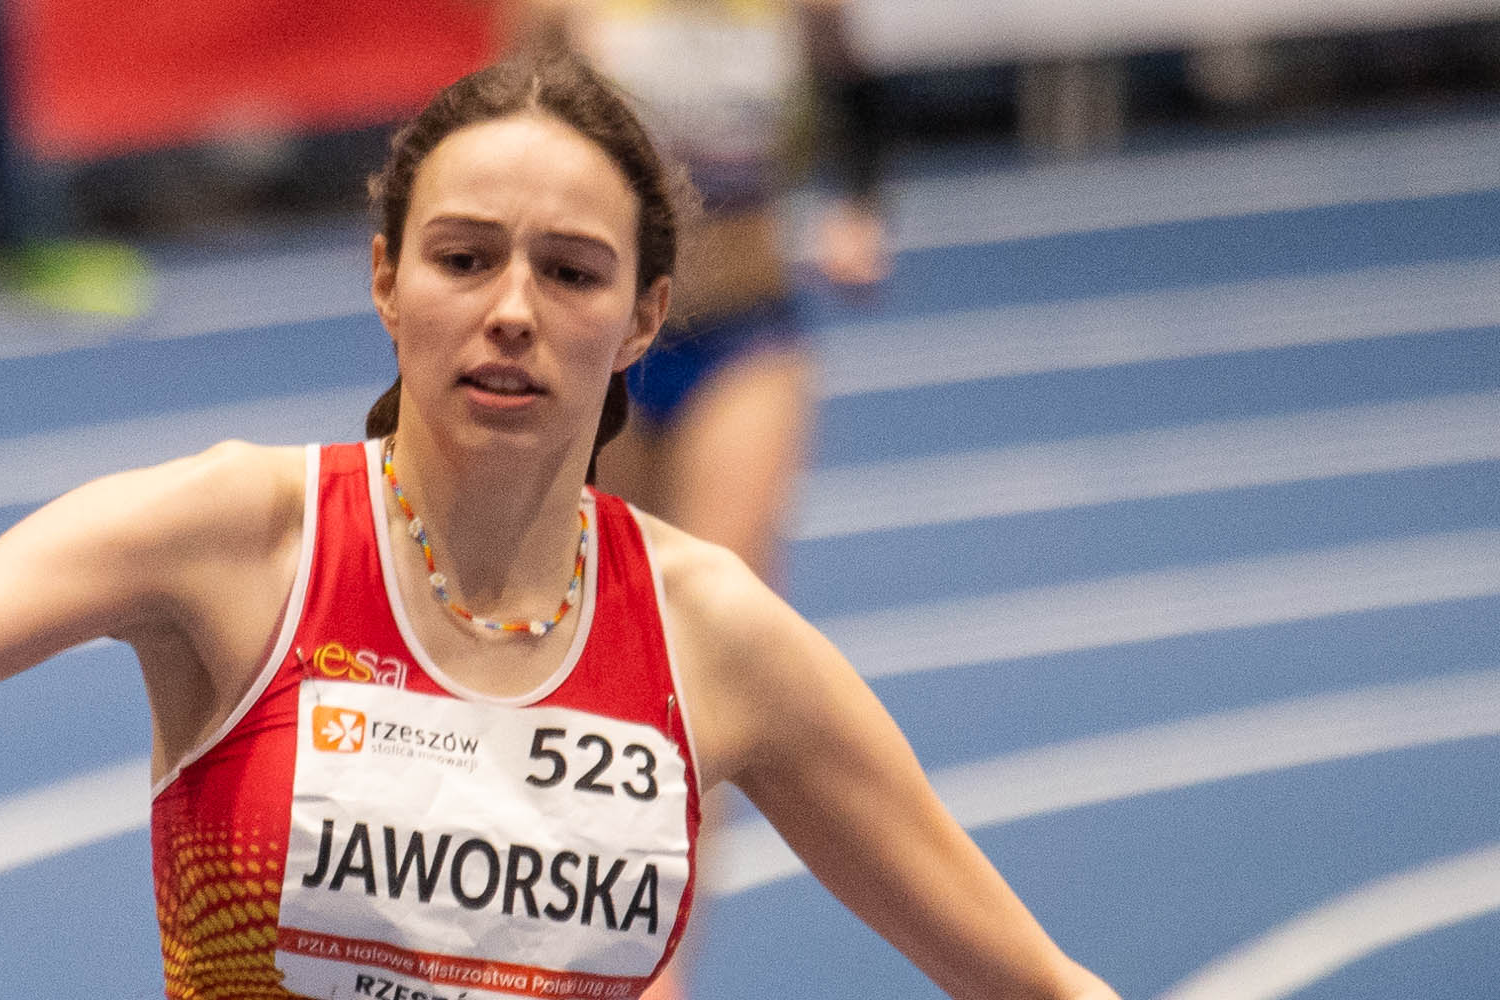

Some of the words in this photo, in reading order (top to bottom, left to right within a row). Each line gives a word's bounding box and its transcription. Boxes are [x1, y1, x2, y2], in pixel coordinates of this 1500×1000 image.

[371, 720, 479, 755] rzeszów
[525, 728, 658, 802] 523
[302, 819, 659, 935] JAWORSKA
[298, 937, 341, 955] PZLA
[346, 945, 415, 969] Halowe
[419, 959, 527, 989] Mistrzostwa
